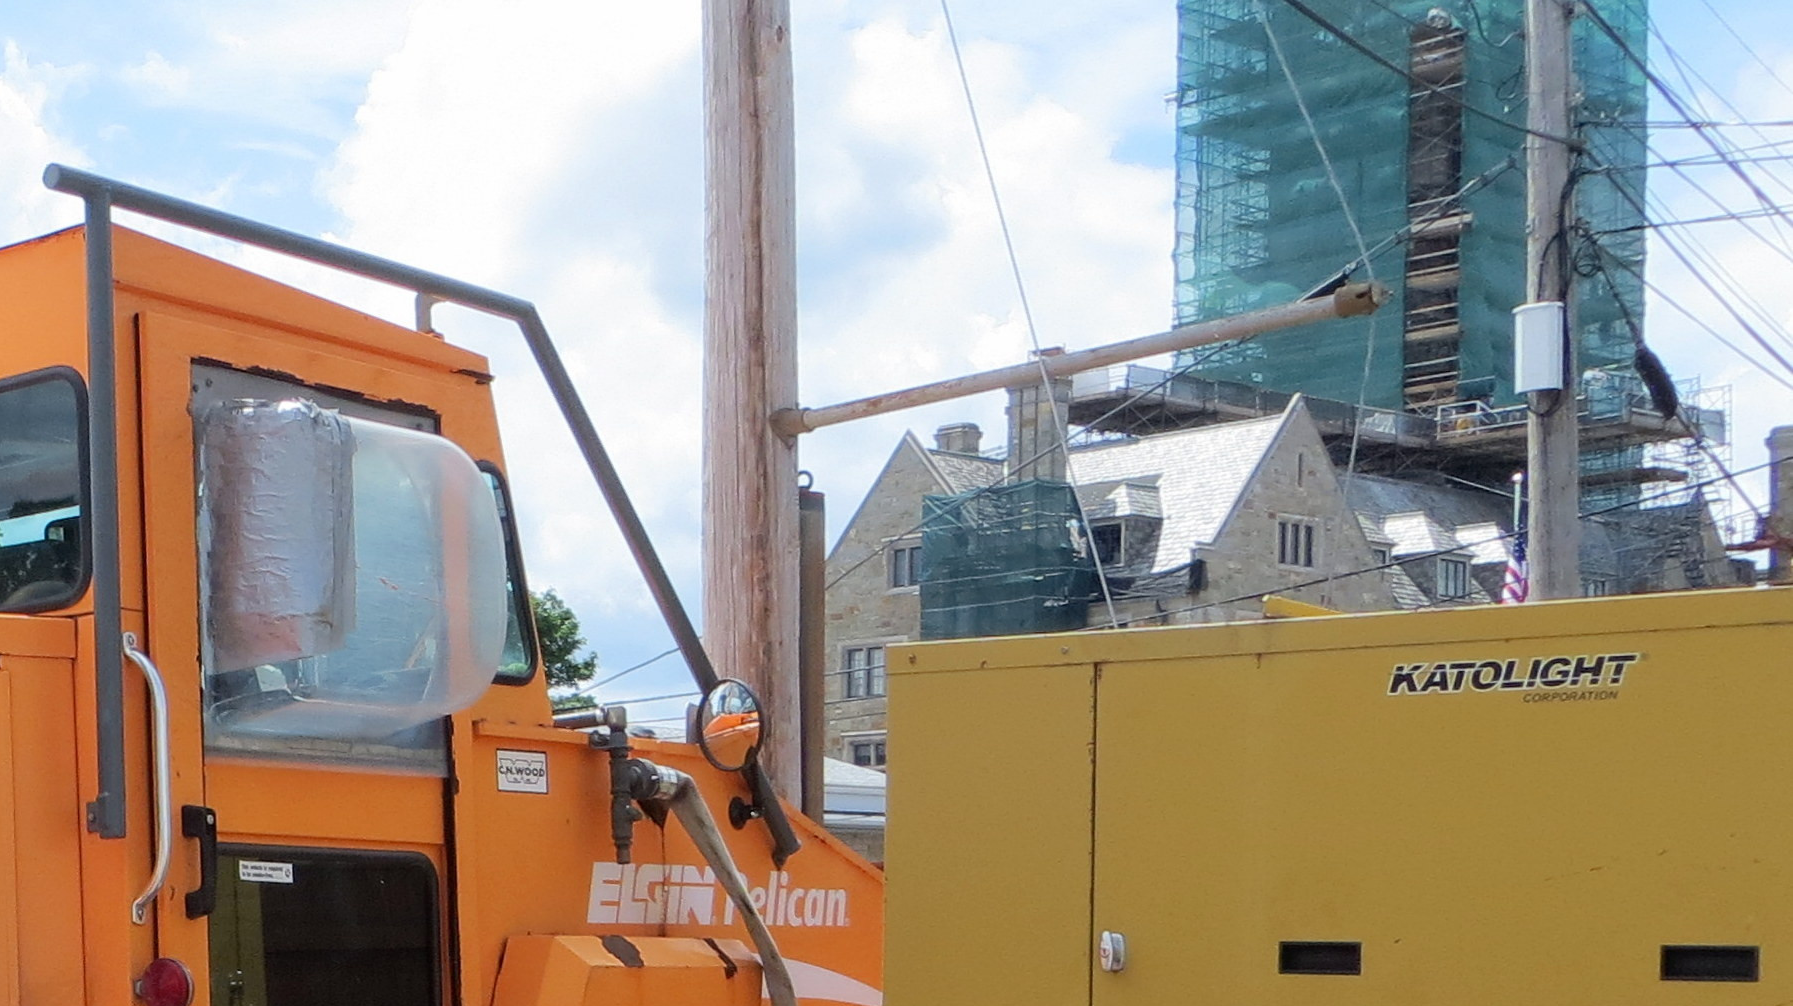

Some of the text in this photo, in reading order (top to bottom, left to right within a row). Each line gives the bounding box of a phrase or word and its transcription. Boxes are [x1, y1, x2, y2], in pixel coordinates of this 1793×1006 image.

[1387, 653, 1638, 695] KATOLIGHT
[1522, 690, 1619, 704] CORPORATION
[587, 862, 714, 925] ELGIN
